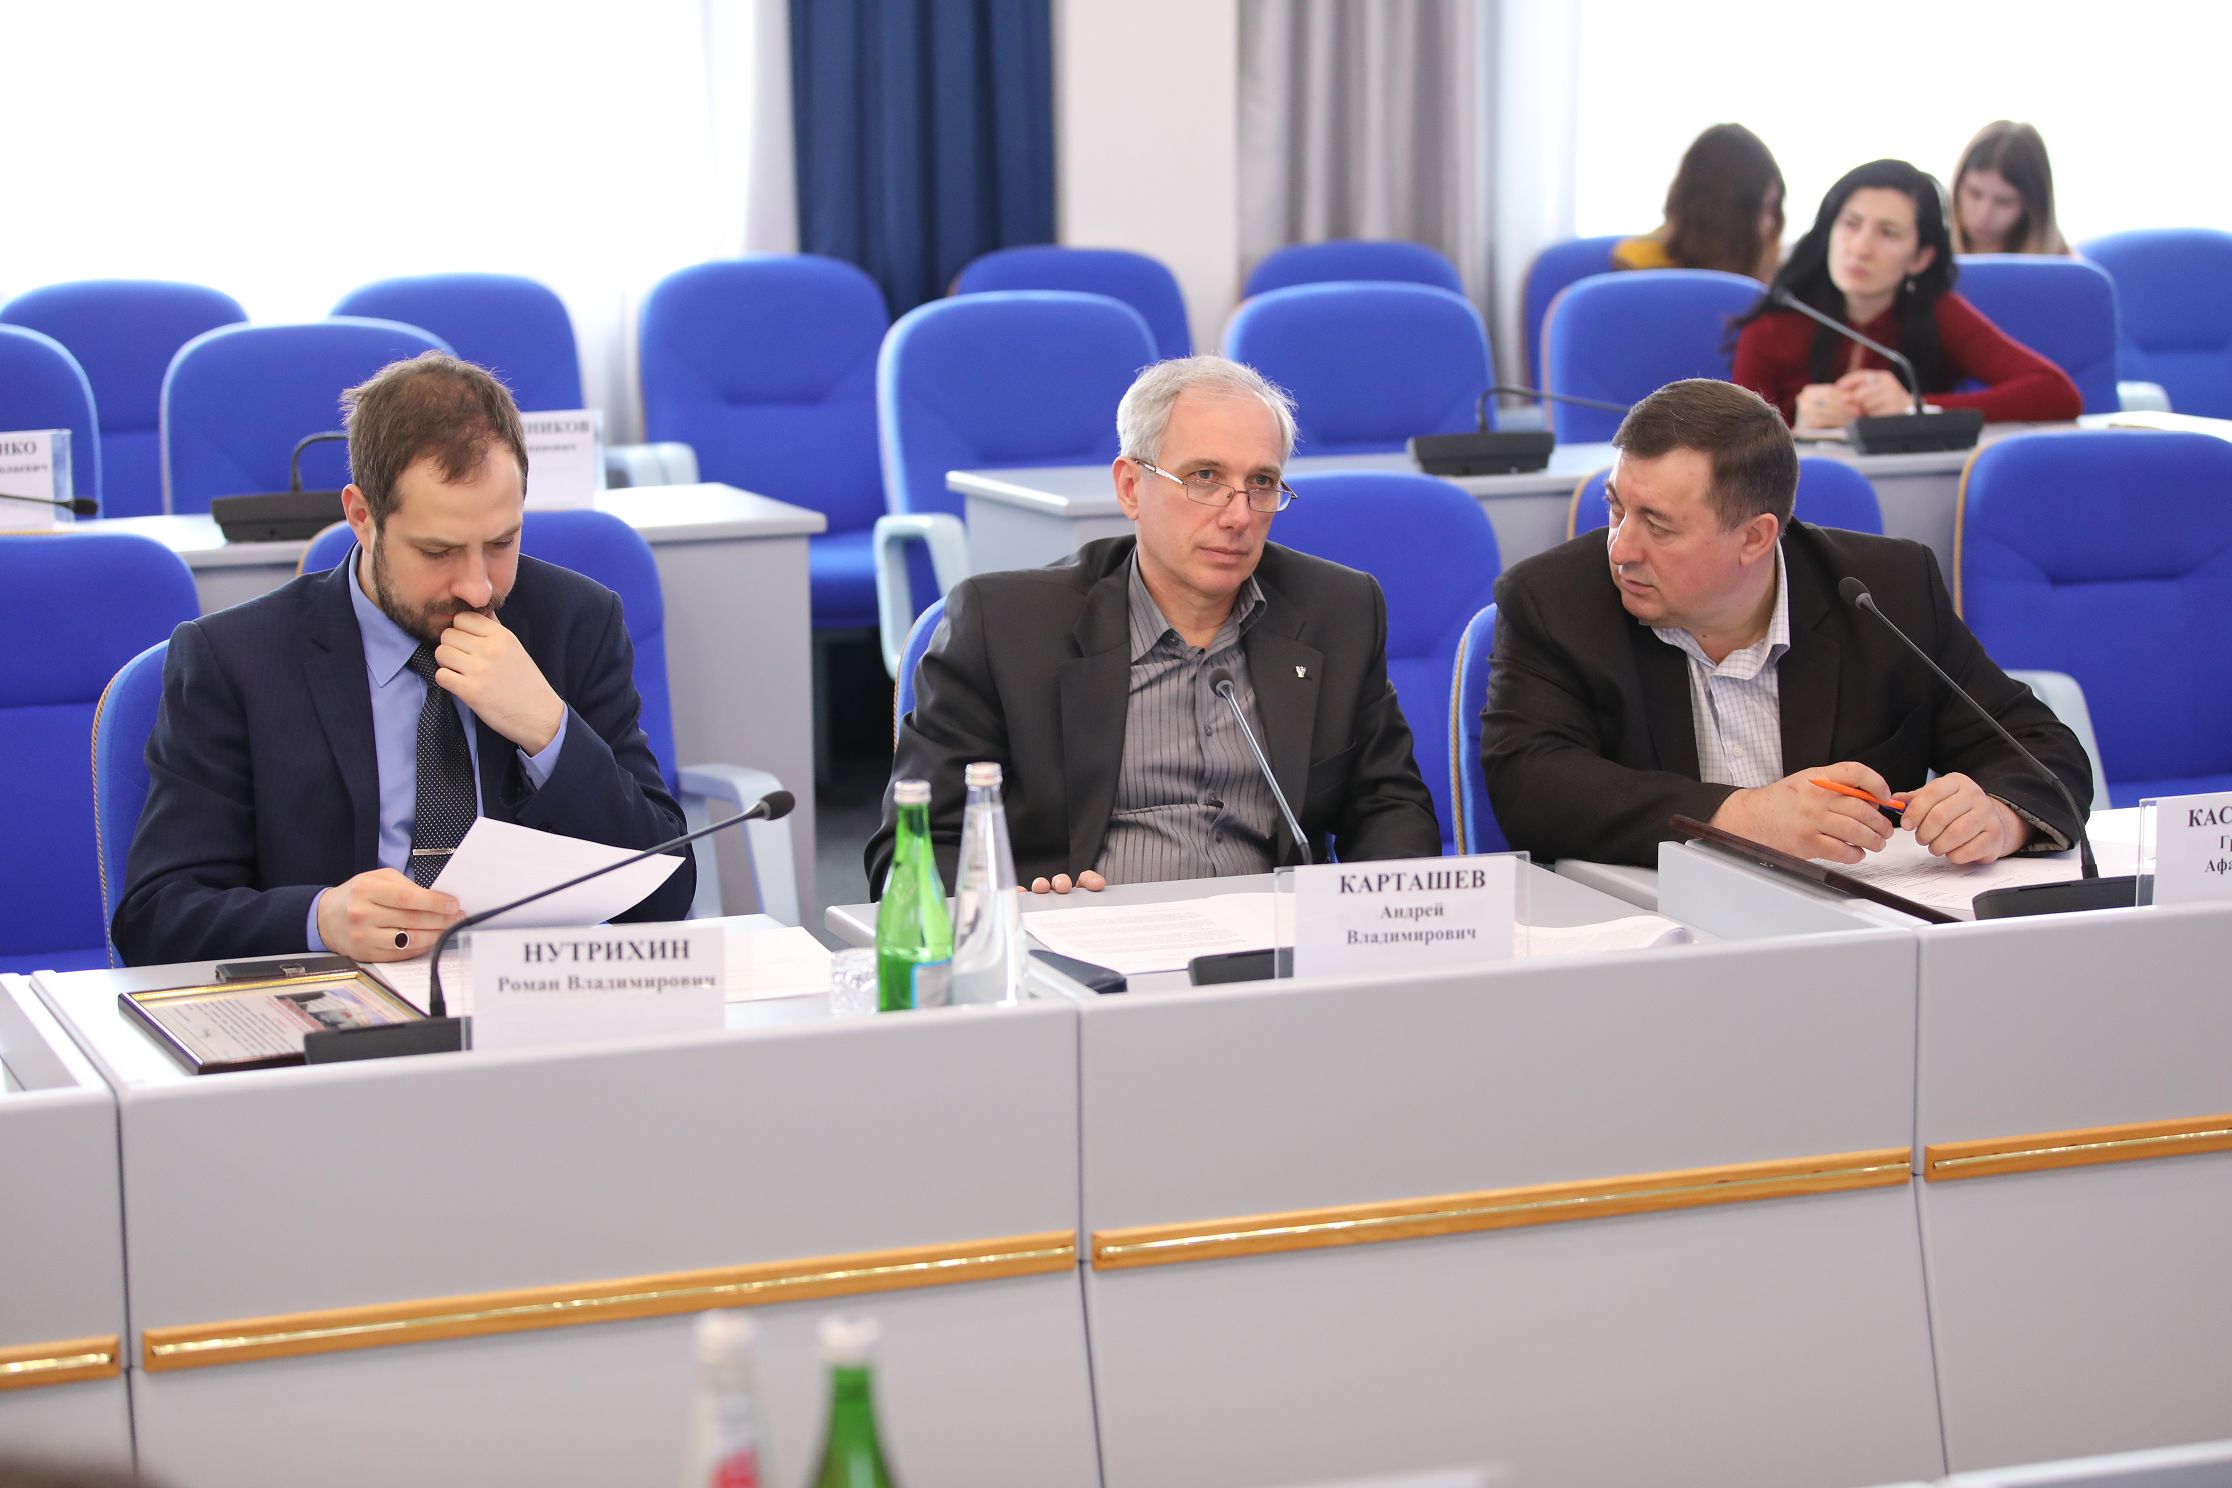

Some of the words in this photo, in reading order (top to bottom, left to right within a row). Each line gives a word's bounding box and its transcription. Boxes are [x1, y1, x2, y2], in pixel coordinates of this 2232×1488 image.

[2188, 805, 2232, 827] КАС
[1339, 869, 1487, 894] КАРТАШЕВ
[1380, 903, 1444, 921] Андрей
[1346, 927, 1477, 945] Владимирович
[523, 939, 690, 963] НУТРИХИН
[498, 976, 560, 992] Роман
[567, 974, 716, 993] Владимирович
